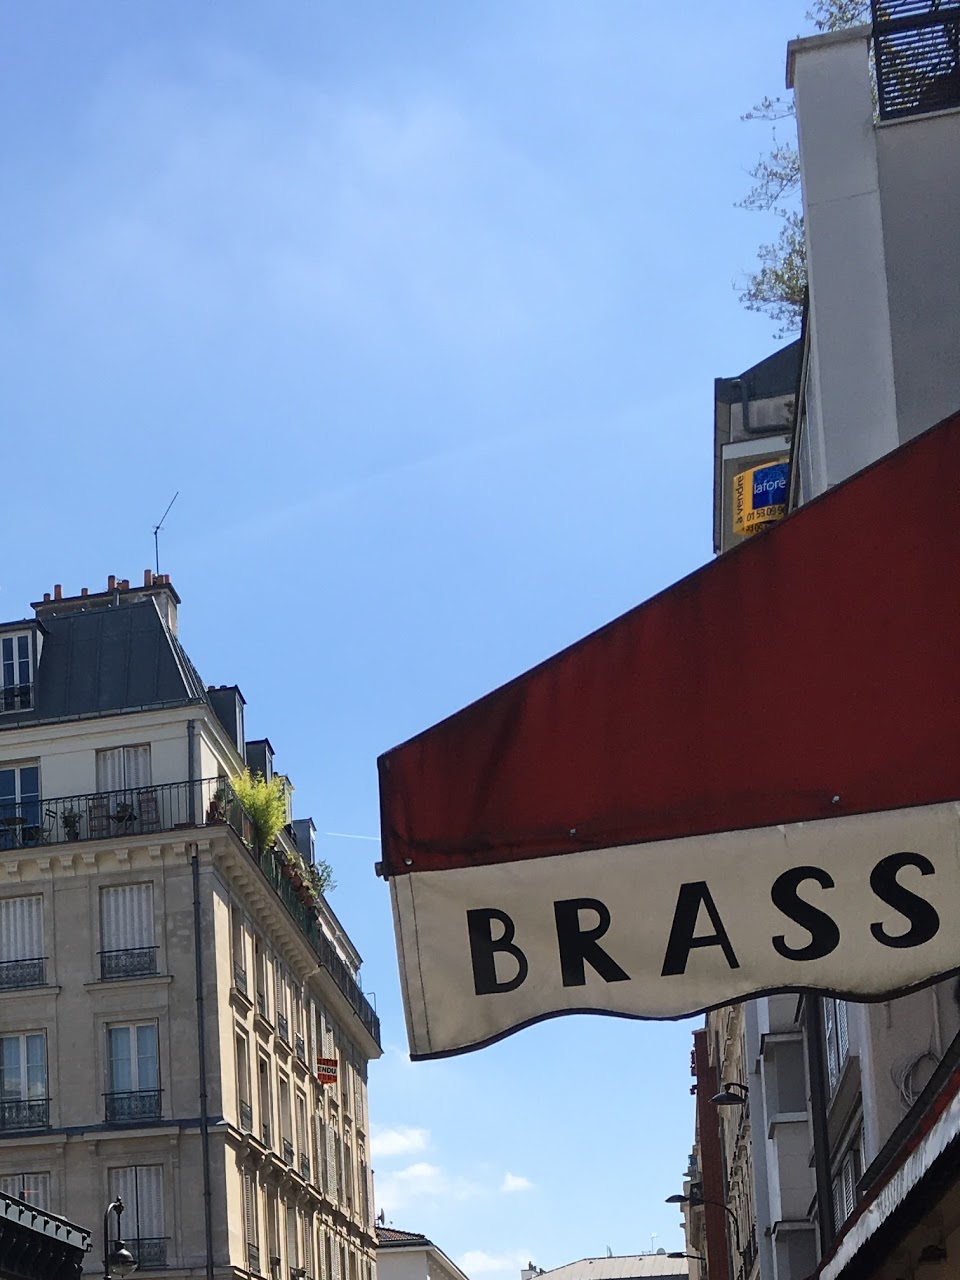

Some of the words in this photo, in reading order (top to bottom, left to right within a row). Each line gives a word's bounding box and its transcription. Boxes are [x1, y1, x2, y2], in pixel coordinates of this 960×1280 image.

[735, 475, 744, 516] vendre
[746, 511, 755, 522] 01
[756, 509, 765, 518] 53
[467, 851, 940, 996] BRASS
